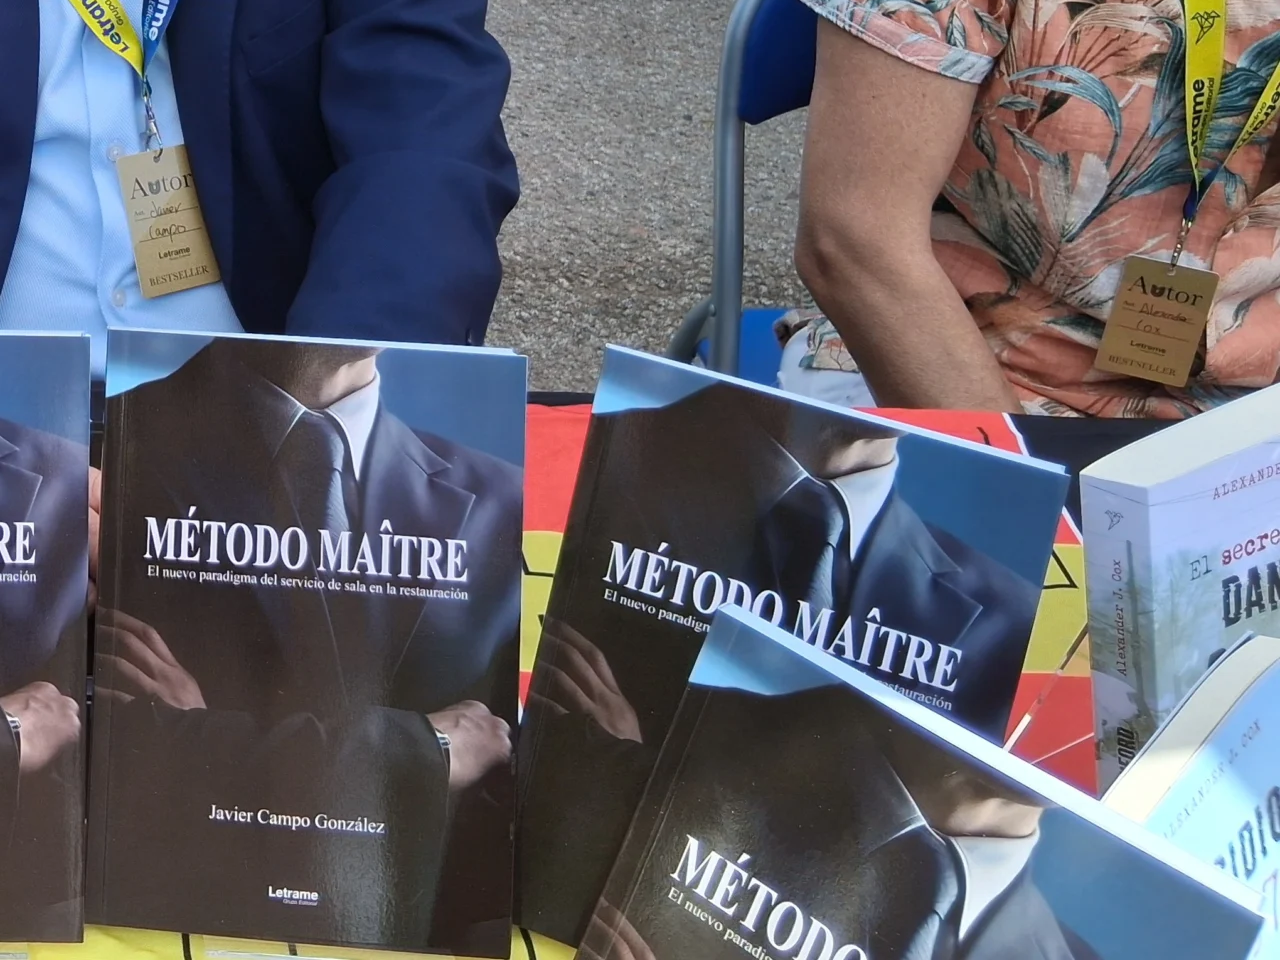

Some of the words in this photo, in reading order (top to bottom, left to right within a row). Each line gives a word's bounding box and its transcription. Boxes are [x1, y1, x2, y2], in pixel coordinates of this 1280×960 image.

[130, 173, 193, 200] Autor
[158, 246, 191, 259] Letrame
[149, 264, 210, 287] BESTSELLER
[1127, 275, 1204, 306] Autor
[1130, 340, 1167, 354] Letrame
[1108, 355, 1177, 377] BESTSELLER
[143, 506, 308, 571] MÉTODO
[317, 519, 468, 582] MAÎTRE
[1111, 559, 1122, 583] Cox
[1190, 555, 1213, 581] El
[147, 565, 160, 577] El
[162, 568, 196, 580] nuevo
[199, 570, 257, 585] paradigma
[260, 572, 277, 585] del
[280, 575, 324, 589] servicio
[328, 578, 341, 590] de
[344, 580, 366, 593] sala
[369, 583, 383, 593] en
[386, 582, 397, 595] la
[400, 584, 469, 600] restauración
[604, 588, 617, 602] El
[620, 596, 656, 614] nuevo
[602, 540, 783, 627] MÉTODO
[793, 600, 963, 692] MAÎTRE
[1116, 604, 1127, 677] Alexander
[209, 804, 254, 823] Javier
[257, 809, 310, 830] Campo
[314, 814, 385, 834] González
[268, 886, 319, 901] Letrame
[668, 887, 682, 905] El
[685, 900, 723, 932] nuevo
